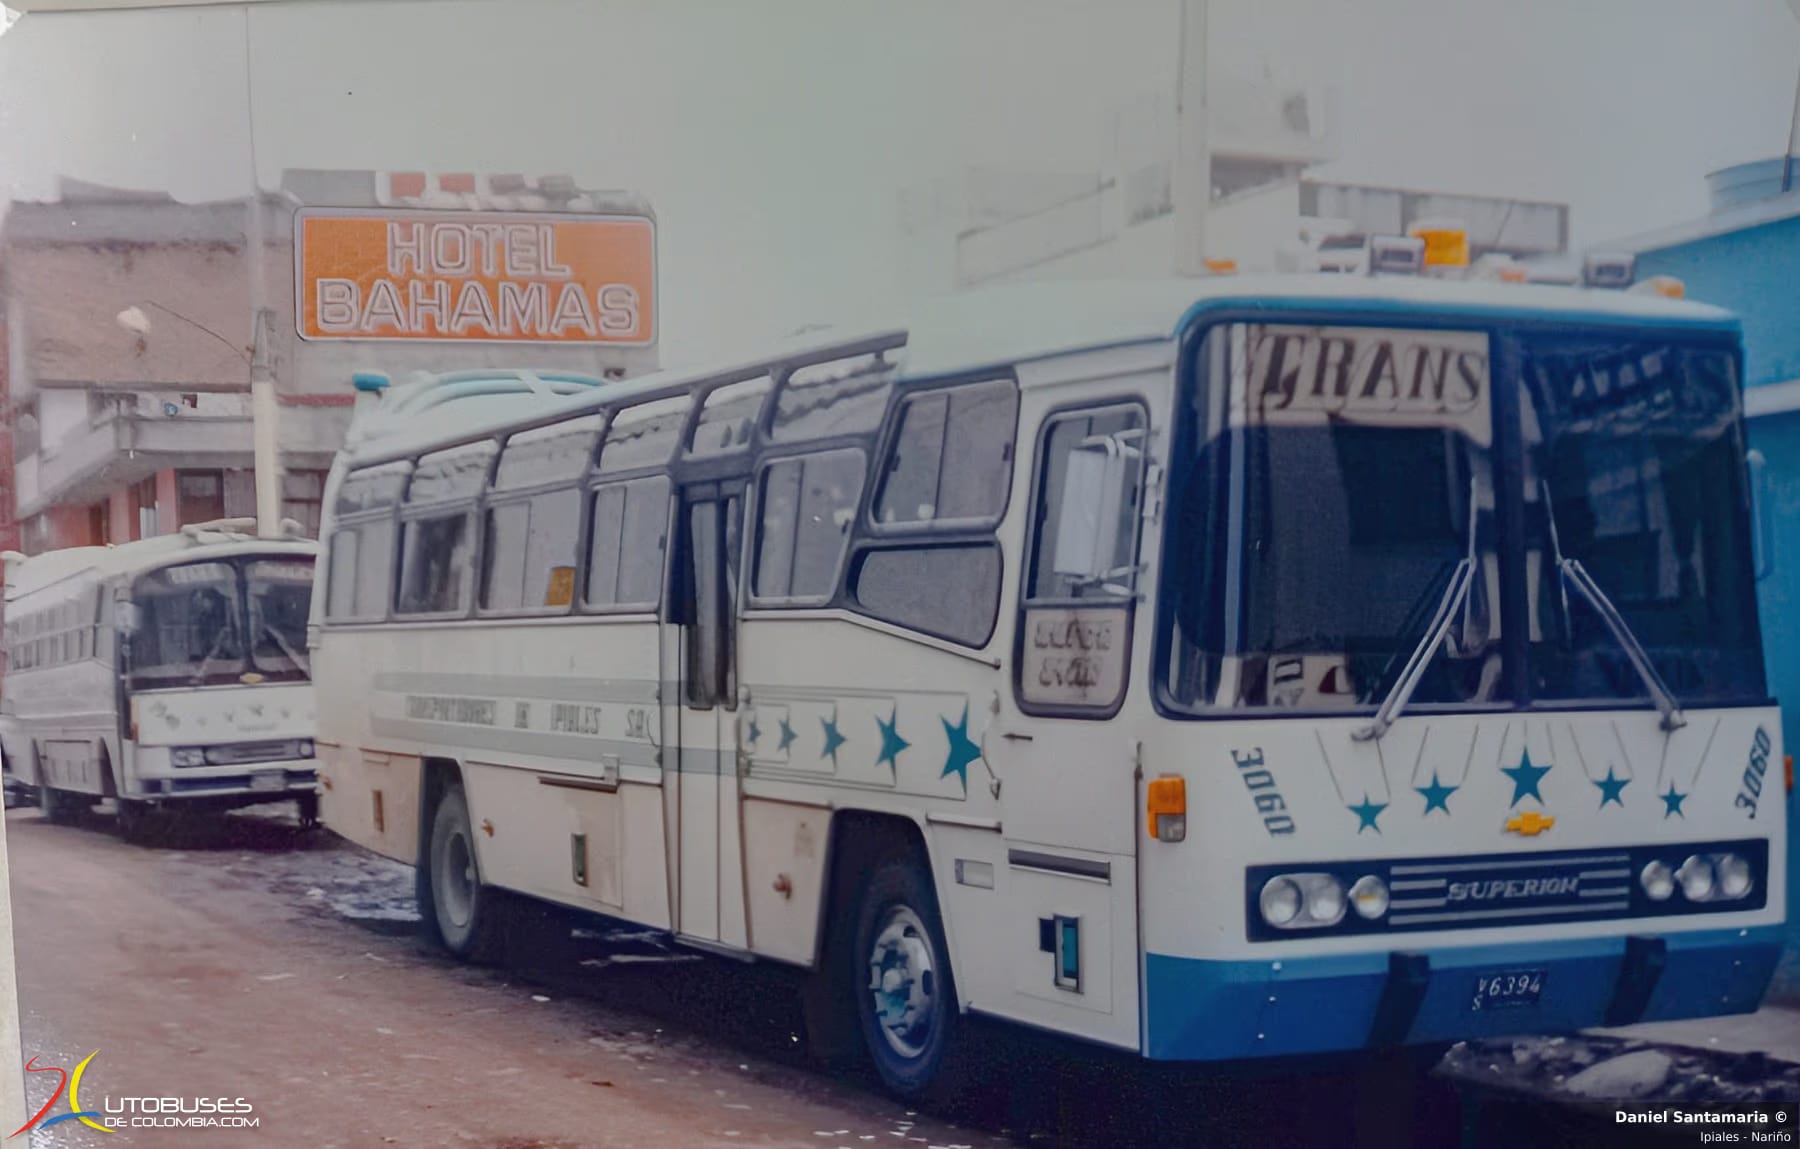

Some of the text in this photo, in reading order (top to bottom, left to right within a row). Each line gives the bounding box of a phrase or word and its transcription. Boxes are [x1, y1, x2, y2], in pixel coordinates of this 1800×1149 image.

[387, 222, 573, 279] HOTEL
[316, 278, 640, 337] BAHAMAS
[1252, 333, 1487, 410] TRANS
[1230, 747, 1297, 837] 3060
[1735, 725, 1771, 820] 3060
